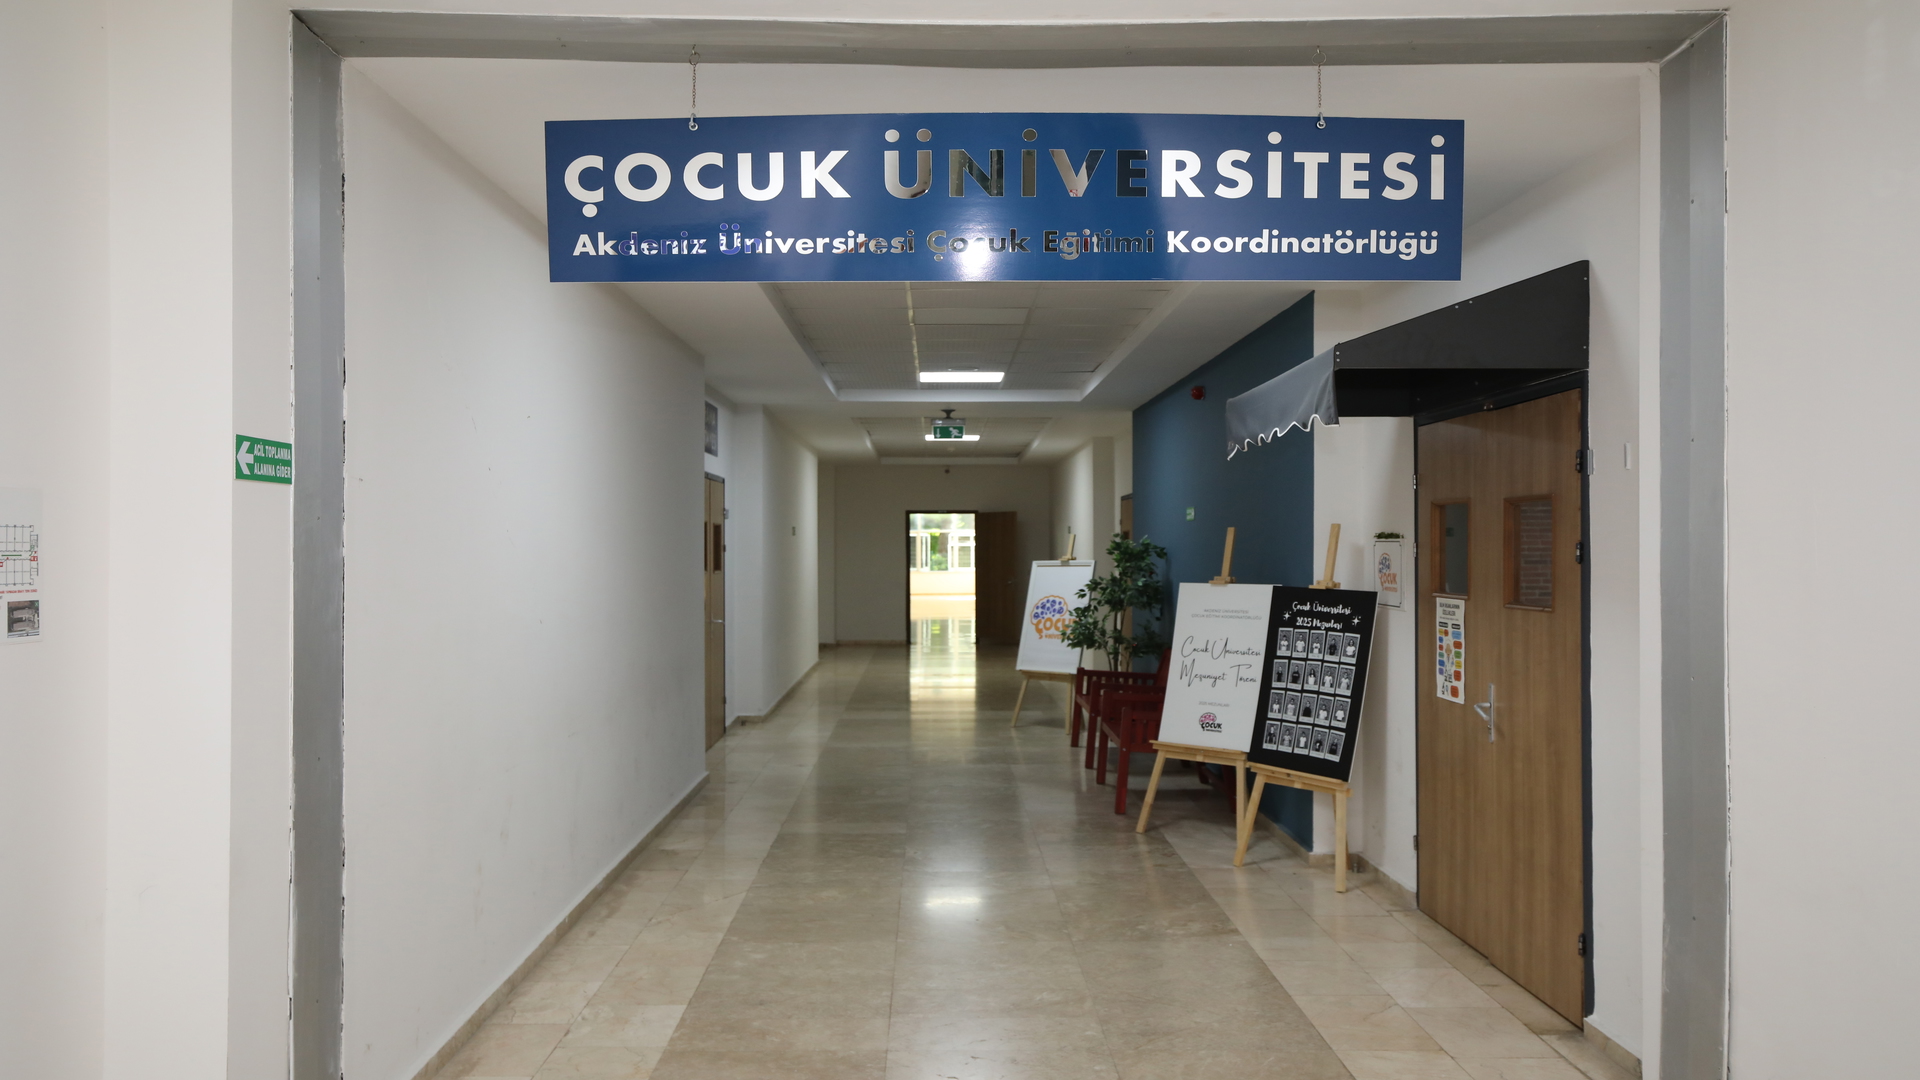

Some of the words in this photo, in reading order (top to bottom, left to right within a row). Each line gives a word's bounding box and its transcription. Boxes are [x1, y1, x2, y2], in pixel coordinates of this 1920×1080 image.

[564, 150, 852, 218] ÇOCUK
[883, 128, 1445, 201] ÜNİVERSİTESİ
[572, 230, 707, 256] Akdeniz
[718, 222, 915, 255] Üniversitesi
[1042, 229, 1155, 261] Eğitimi
[1166, 229, 1438, 261] Koordinatörlüğü
[265, 445, 291, 460] TOPLANMA
[1034, 617, 1078, 640] ÇOCU
[1296, 616, 1311, 627] 2025
